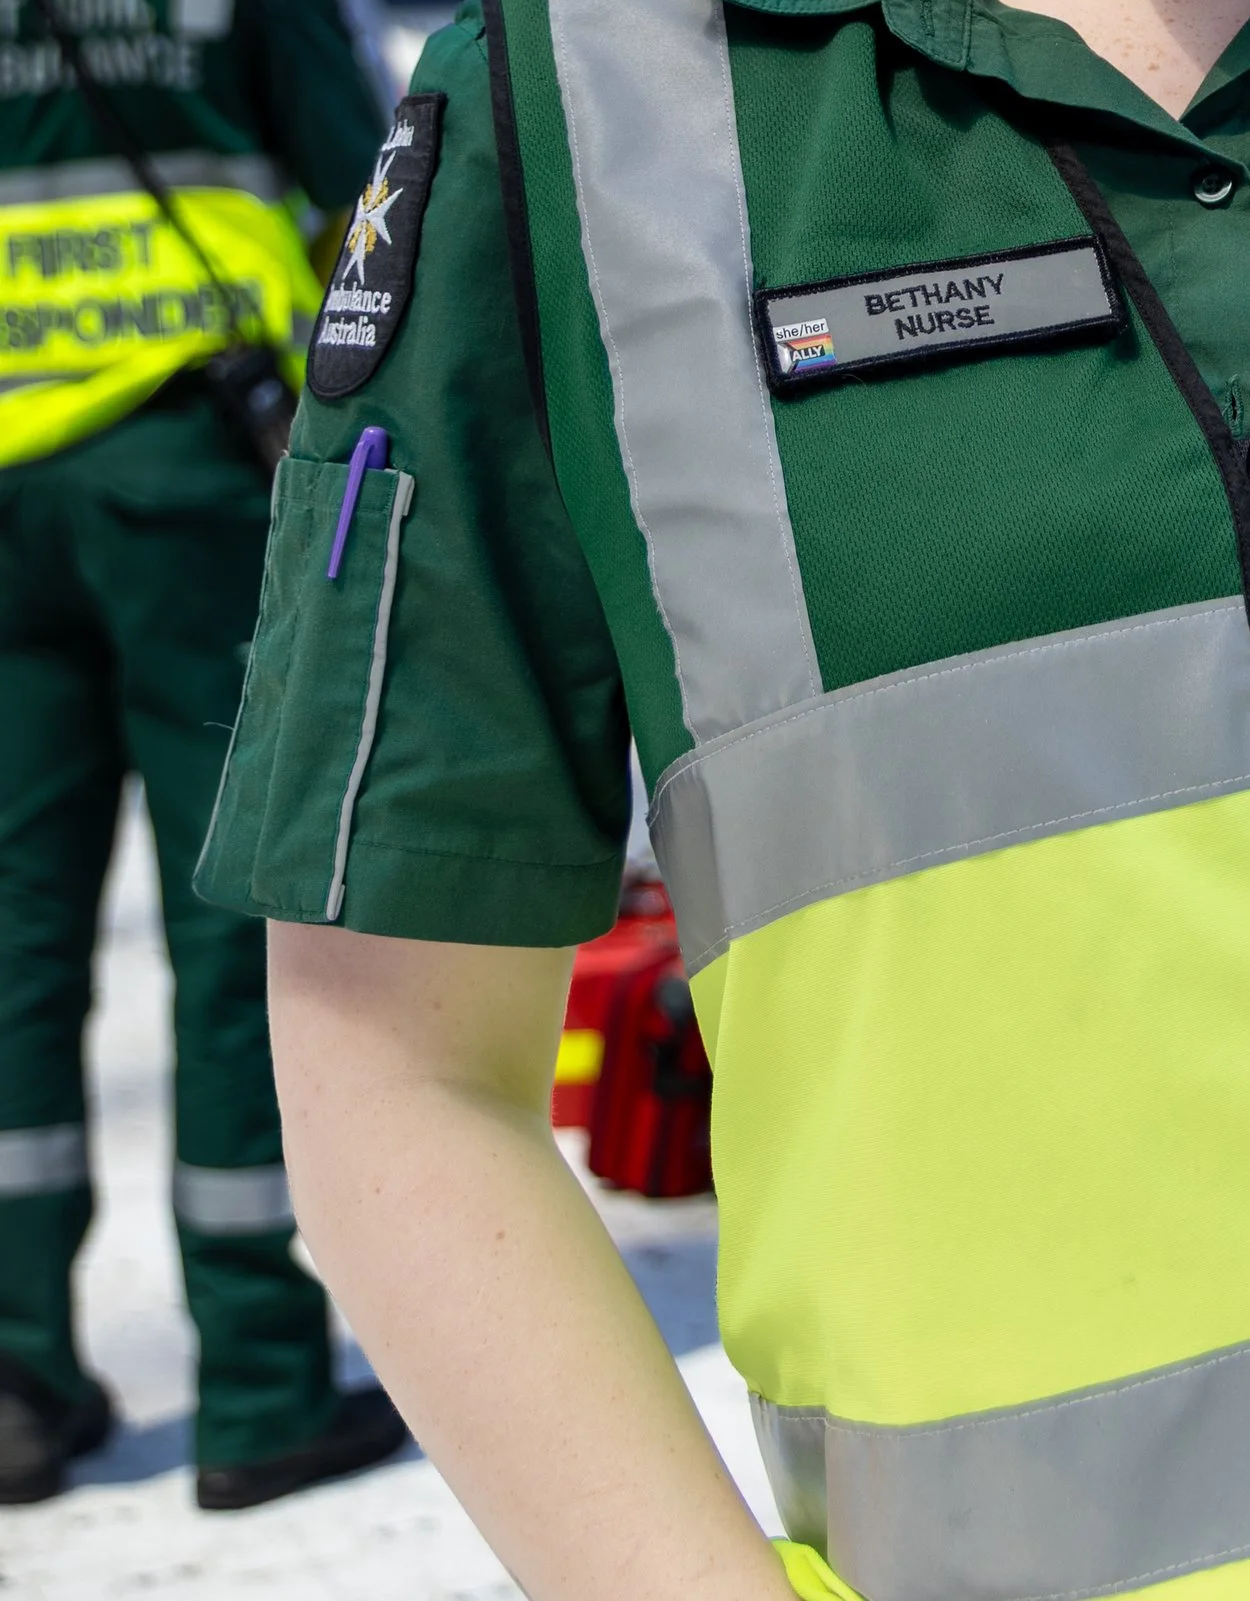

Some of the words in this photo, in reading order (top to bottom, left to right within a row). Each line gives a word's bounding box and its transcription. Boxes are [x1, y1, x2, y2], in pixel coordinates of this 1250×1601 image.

[8, 224, 153, 278] FIRST
[864, 273, 1004, 316] BETHANY
[776, 322, 825, 340] she/her
[894, 305, 995, 340] NURSE
[792, 345, 823, 362] ALLY
